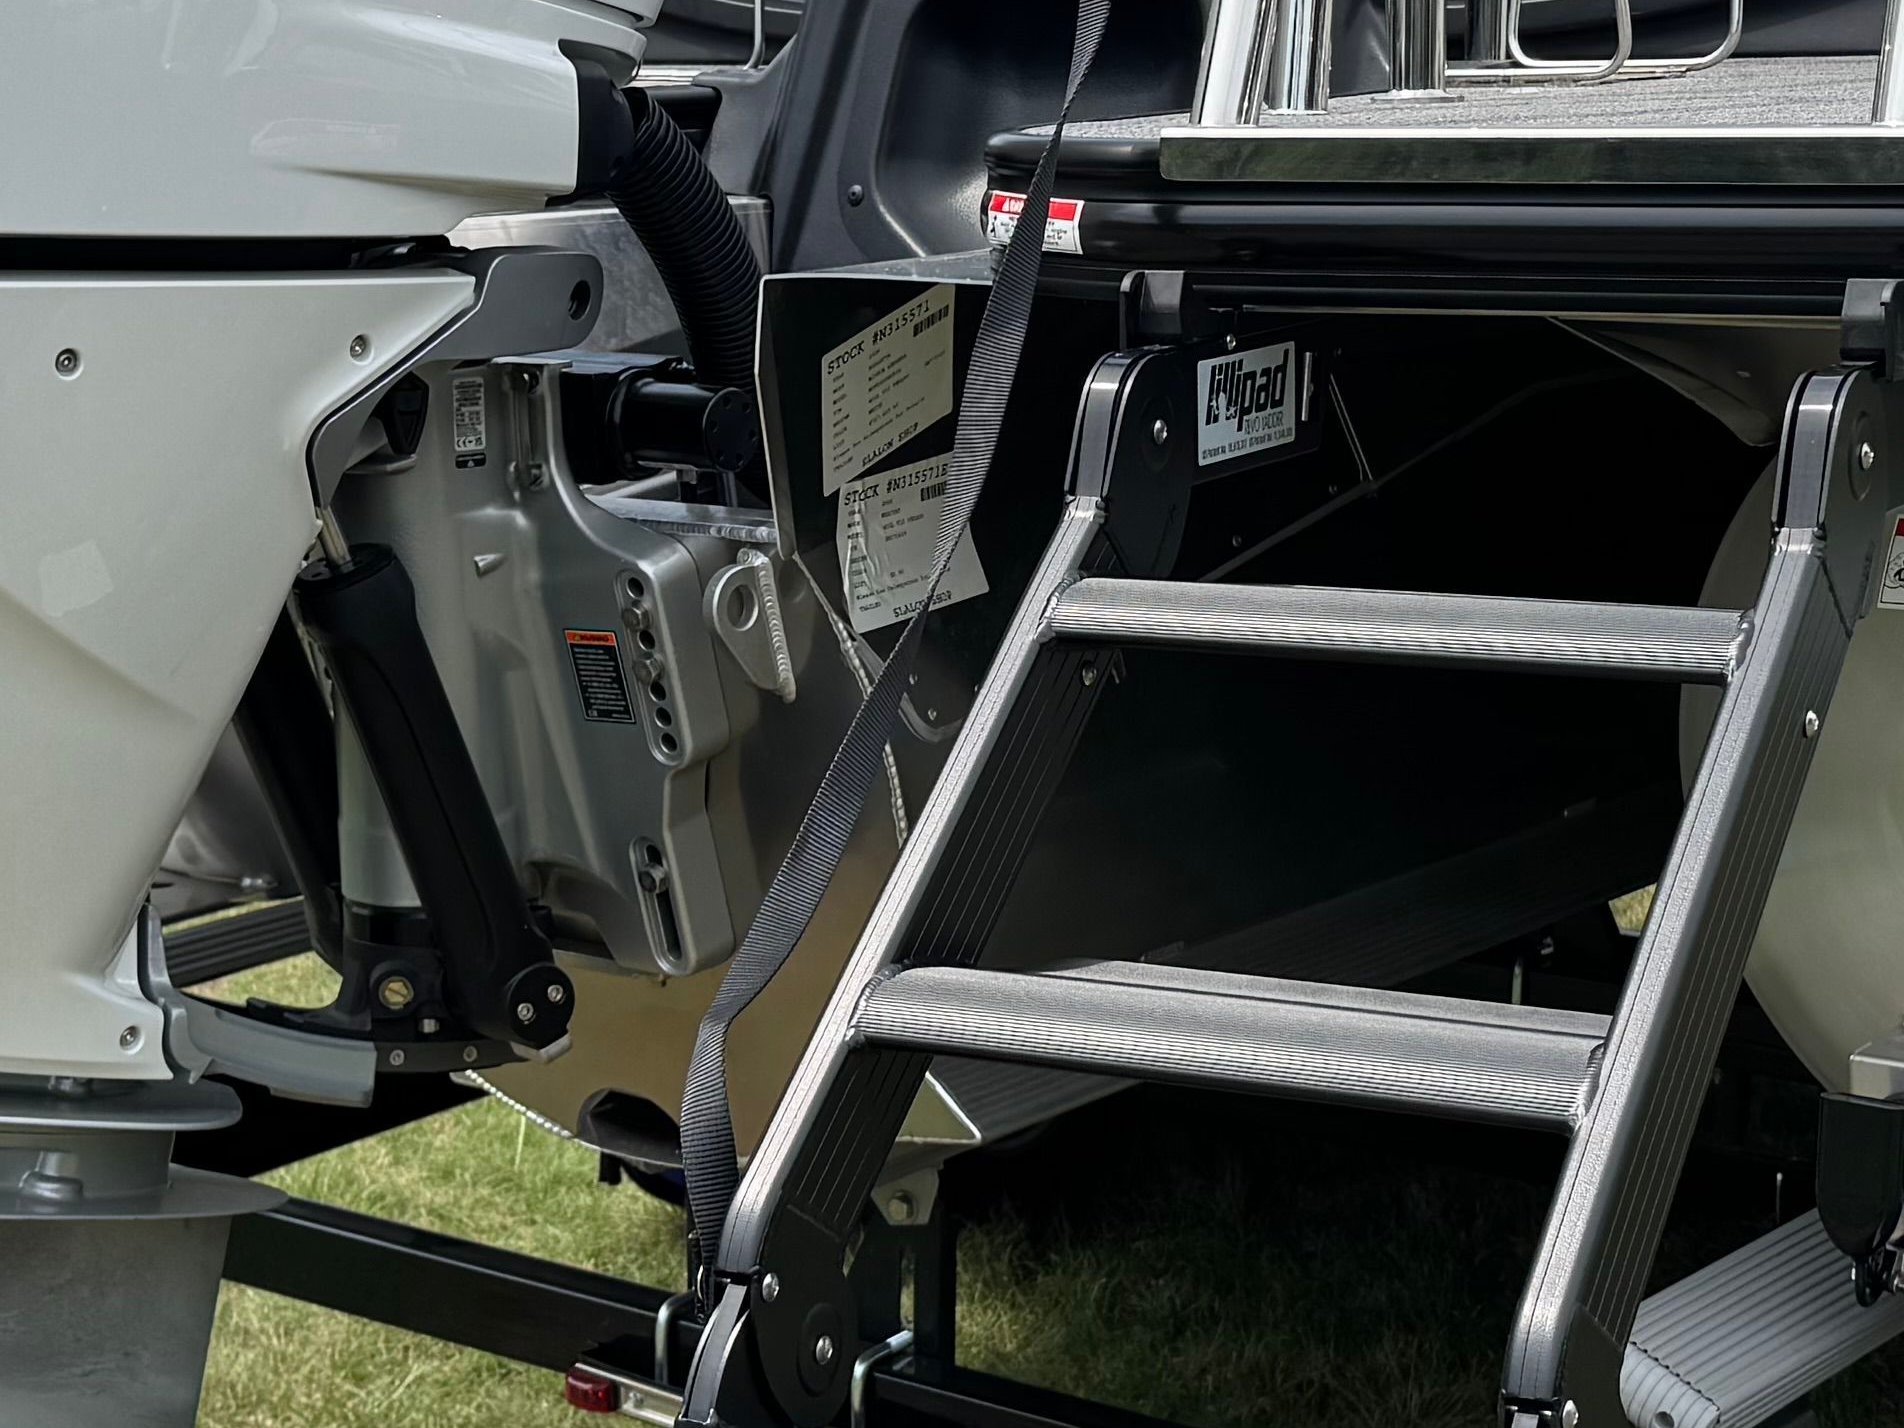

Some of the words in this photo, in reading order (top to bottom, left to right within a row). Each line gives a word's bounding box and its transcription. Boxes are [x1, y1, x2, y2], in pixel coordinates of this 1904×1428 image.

[827, 340, 865, 375] STOCK
[872, 299, 930, 346] #N315571
[844, 484, 880, 506] STOCK
